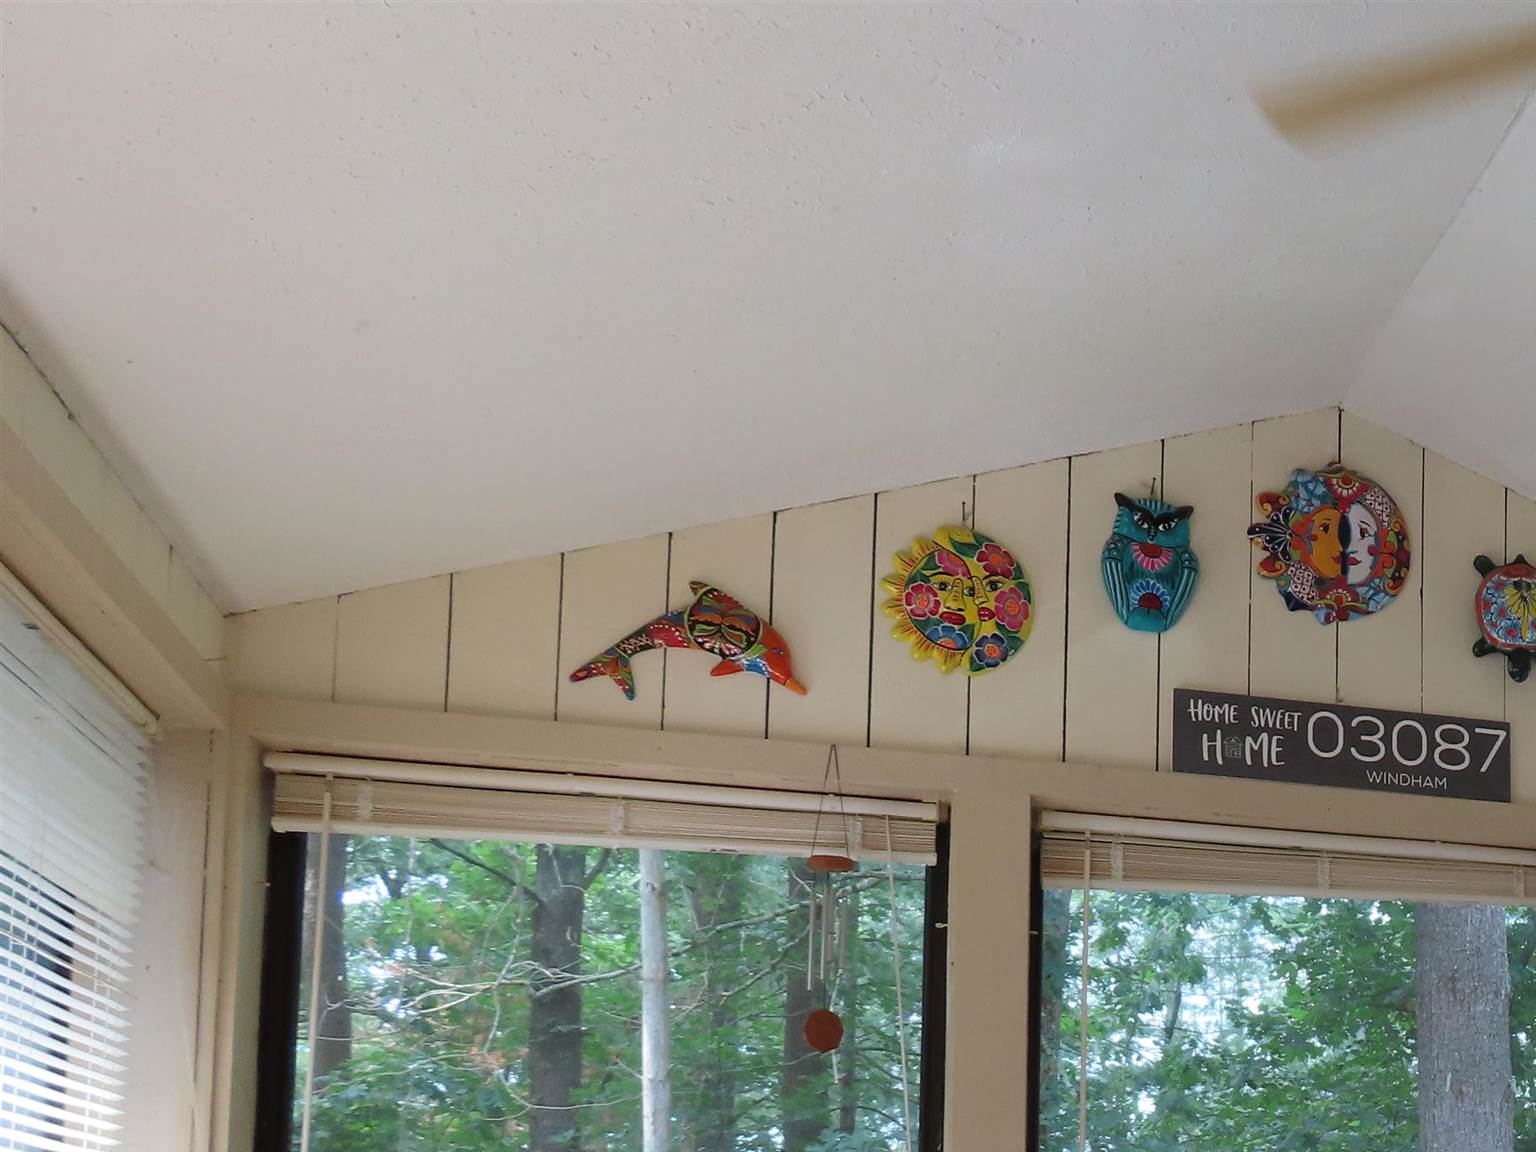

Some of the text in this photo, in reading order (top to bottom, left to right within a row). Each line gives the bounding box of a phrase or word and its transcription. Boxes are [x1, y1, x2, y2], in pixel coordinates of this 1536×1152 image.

[1187, 698, 1302, 732] HOME SWEET
[1307, 710, 1507, 773] 03087
[1366, 770, 1448, 790] WINDHAM
